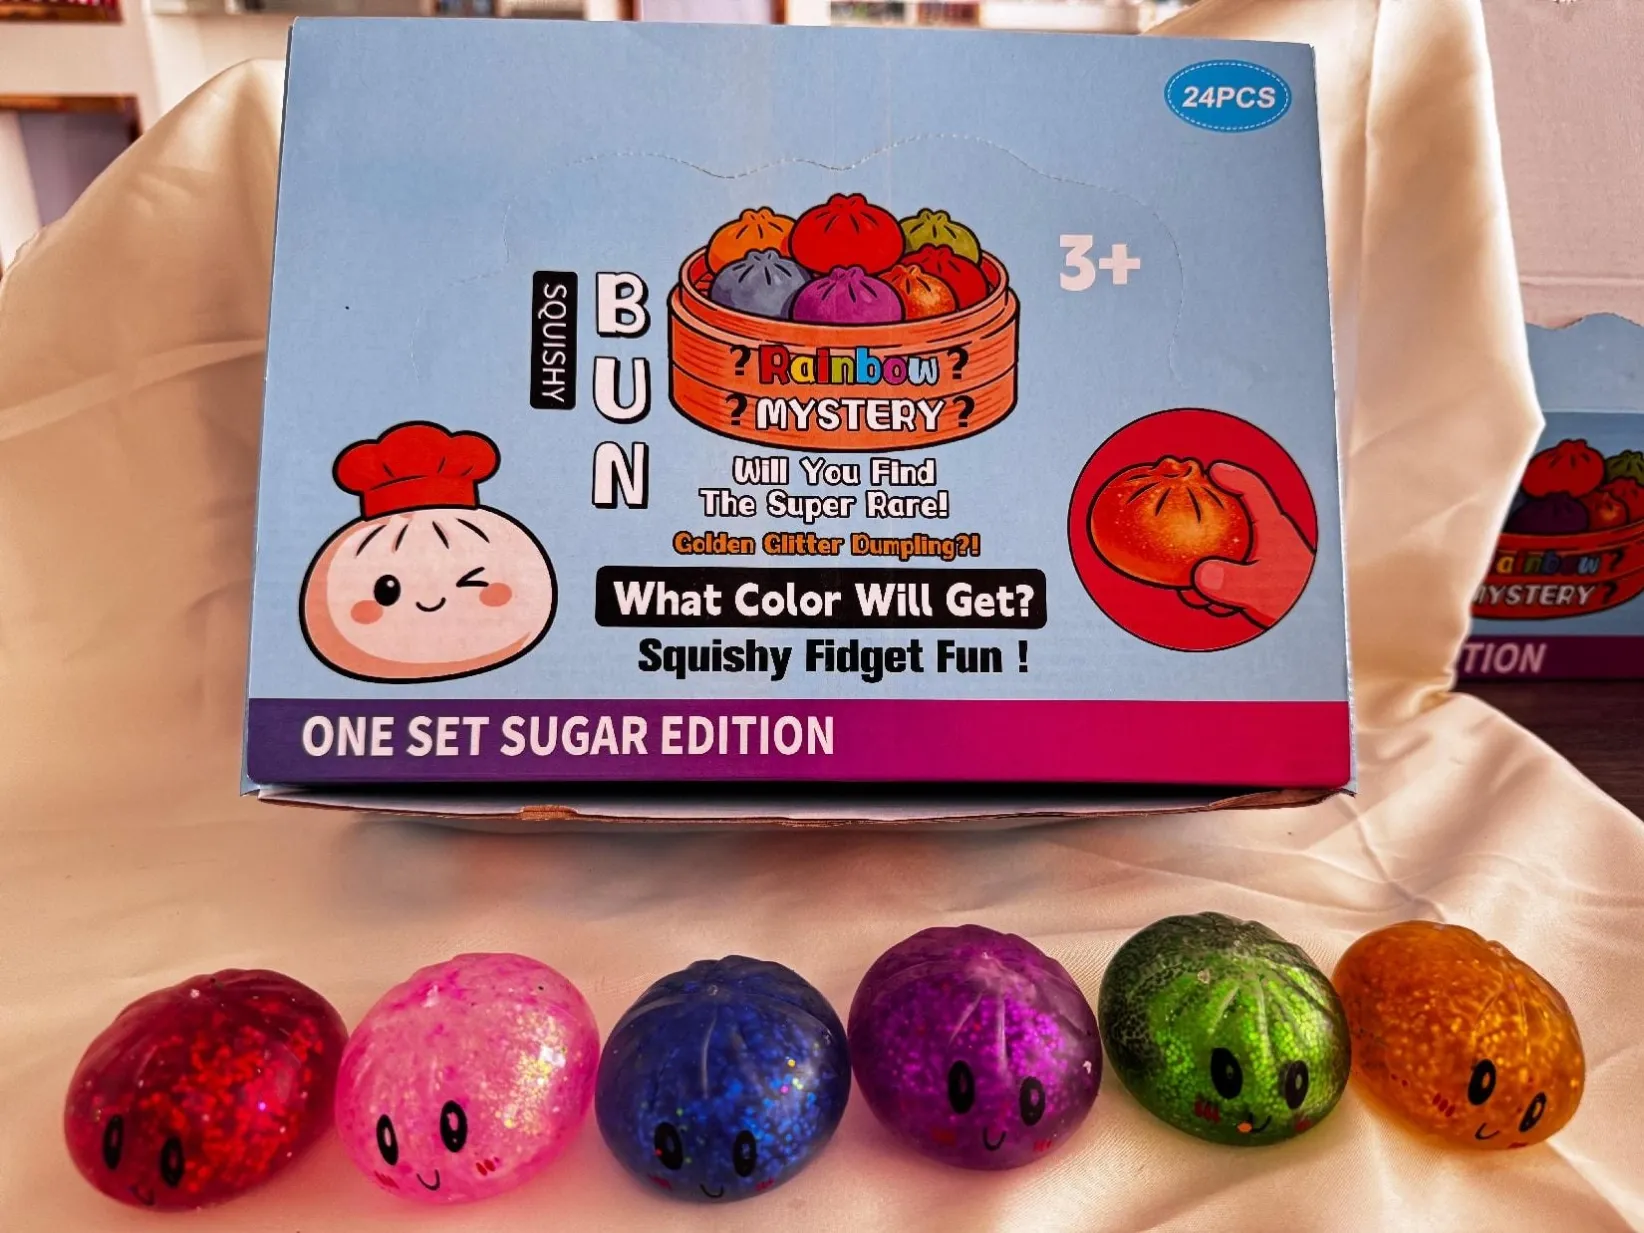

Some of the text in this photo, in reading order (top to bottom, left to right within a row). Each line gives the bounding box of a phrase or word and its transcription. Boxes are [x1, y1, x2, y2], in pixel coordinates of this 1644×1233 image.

[1182, 86, 1275, 109] 24PCS
[1059, 234, 1141, 292] 3+
[537, 283, 568, 403] SQUISHY
[758, 345, 940, 386] Rainbow
[592, 271, 651, 509] BUN
[755, 398, 946, 432] MYSTERY
[732, 456, 936, 486] Will You Find
[699, 488, 949, 524] The Super Rare!
[673, 531, 981, 561] Golden Glitter Dumpling?!
[1495, 550, 1600, 575] ainbow
[613, 581, 1035, 618] What Color Will Get?
[638, 638, 792, 681] Squishy
[805, 639, 924, 684] Fidget
[937, 640, 1002, 673] Fun
[302, 716, 835, 757] ONE SET SUGAR EDITION
